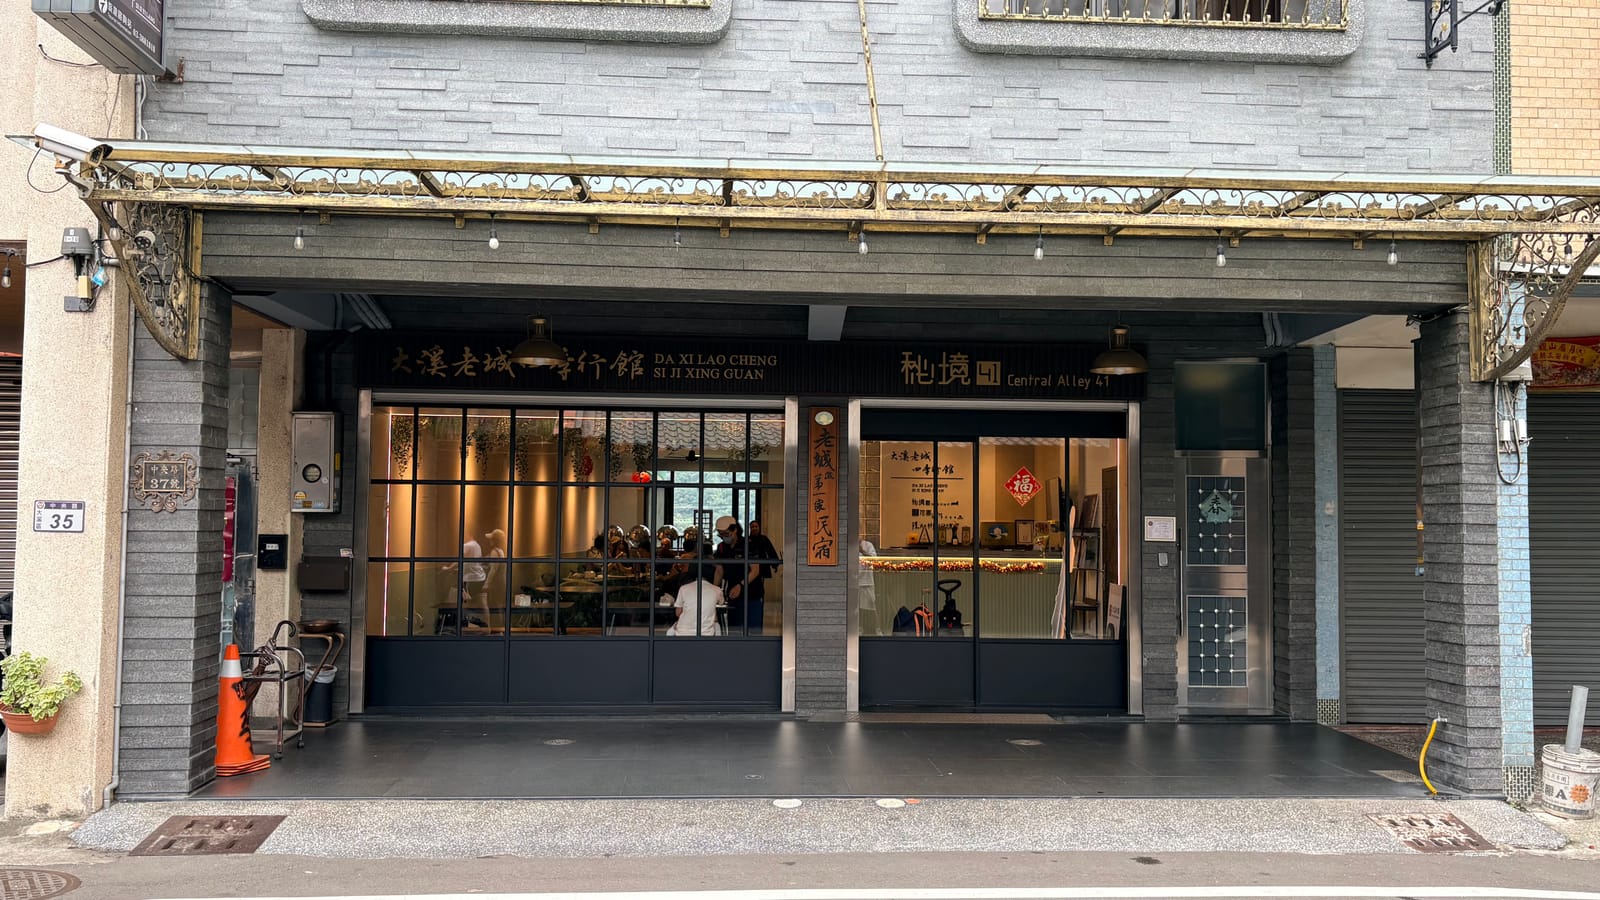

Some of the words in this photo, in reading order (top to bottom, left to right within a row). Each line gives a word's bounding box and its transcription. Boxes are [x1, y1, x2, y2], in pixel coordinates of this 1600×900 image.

[654, 353, 675, 365] DA
[679, 353, 694, 365] XI
[697, 353, 727, 366] LAO
[729, 354, 779, 367] CHENG
[653, 367, 666, 379] SI
[670, 367, 682, 379] JI
[685, 367, 720, 380] XING
[723, 368, 765, 381] GUAN
[900, 351, 972, 386] 秘境
[1007, 374, 1052, 388] Central
[1057, 374, 1092, 390] Alley
[1095, 375, 1110, 388] 41
[1013, 474, 1034, 494] 福
[50, 513, 74, 529] 35
